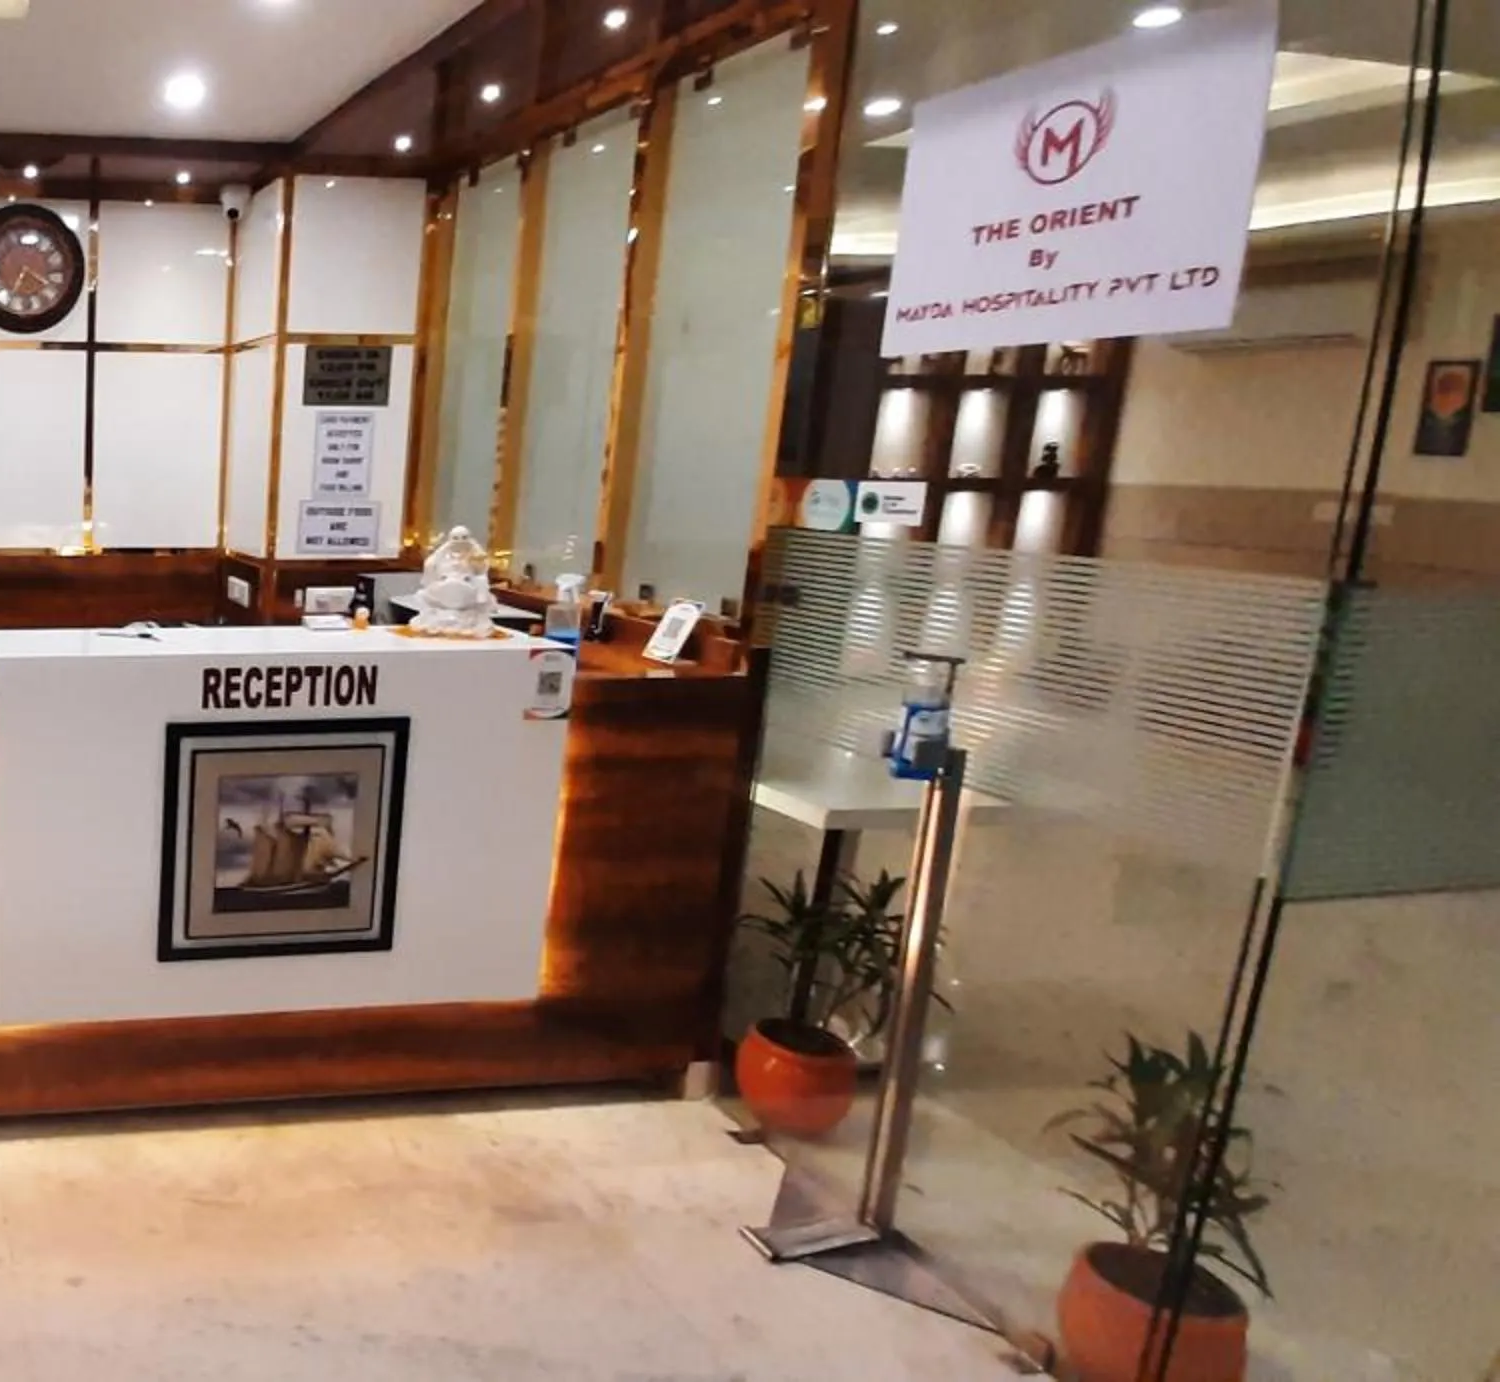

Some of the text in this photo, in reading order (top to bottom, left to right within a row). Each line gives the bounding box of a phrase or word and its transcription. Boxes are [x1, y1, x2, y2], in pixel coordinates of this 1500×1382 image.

[972, 195, 1141, 246] THE ORIENT
[1028, 249, 1060, 270] By
[962, 280, 1099, 314] HOSPITALITY
[1107, 272, 1160, 297] PVT
[1169, 265, 1220, 291] LTD
[202, 665, 378, 709] RECEPTION
